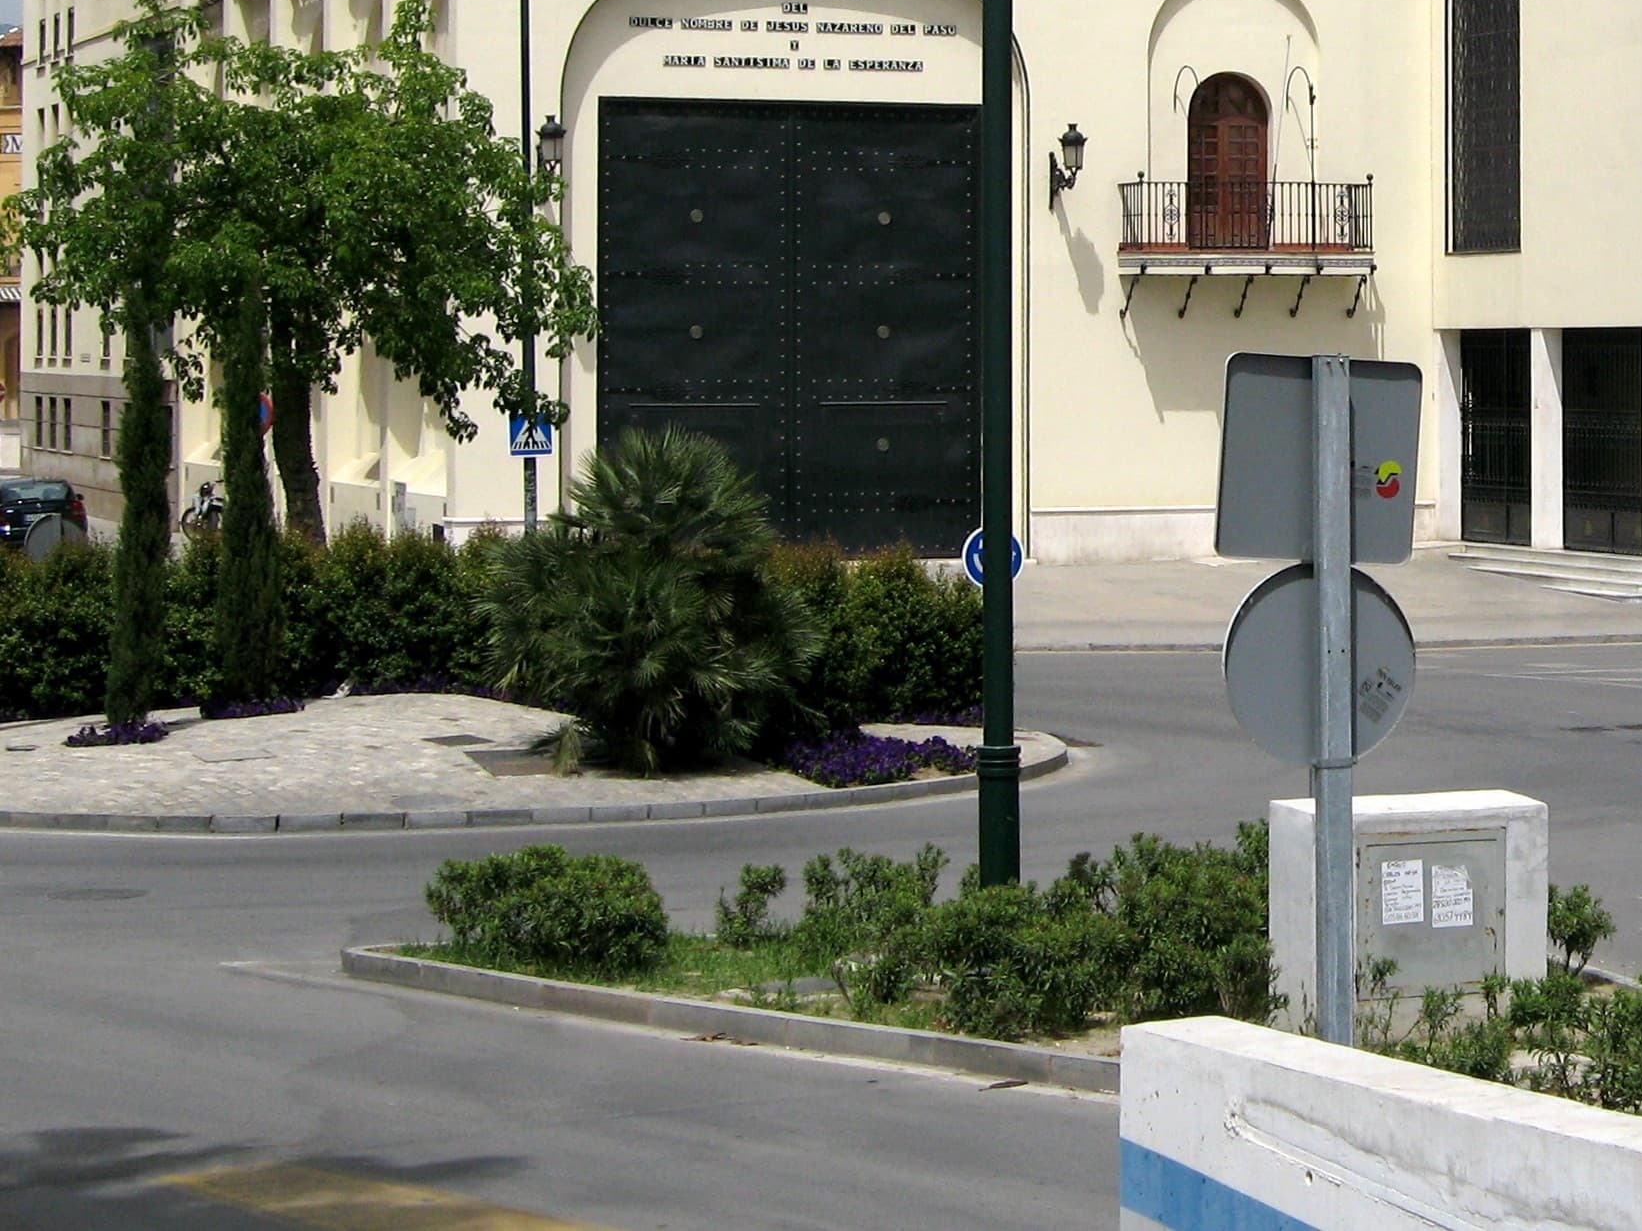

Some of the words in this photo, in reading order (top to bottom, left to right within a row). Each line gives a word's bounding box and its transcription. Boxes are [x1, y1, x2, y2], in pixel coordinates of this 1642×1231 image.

[782, 2, 809, 14] DEL
[629, 16, 673, 29] DULCE
[681, 18, 733, 31] NOMBRE
[740, 20, 758, 32] DE
[766, 20, 809, 32] JESUS
[816, 22, 883, 35] NAZARENO
[890, 24, 916, 36] DEL
[923, 24, 957, 36] PASO
[790, 40, 799, 51] Y
[663, 55, 706, 67] MARIA
[713, 56, 790, 69] SANTISIMA
[798, 58, 816, 70] DE
[823, 58, 841, 71] LA
[848, 59, 924, 73] ESPERANZA
